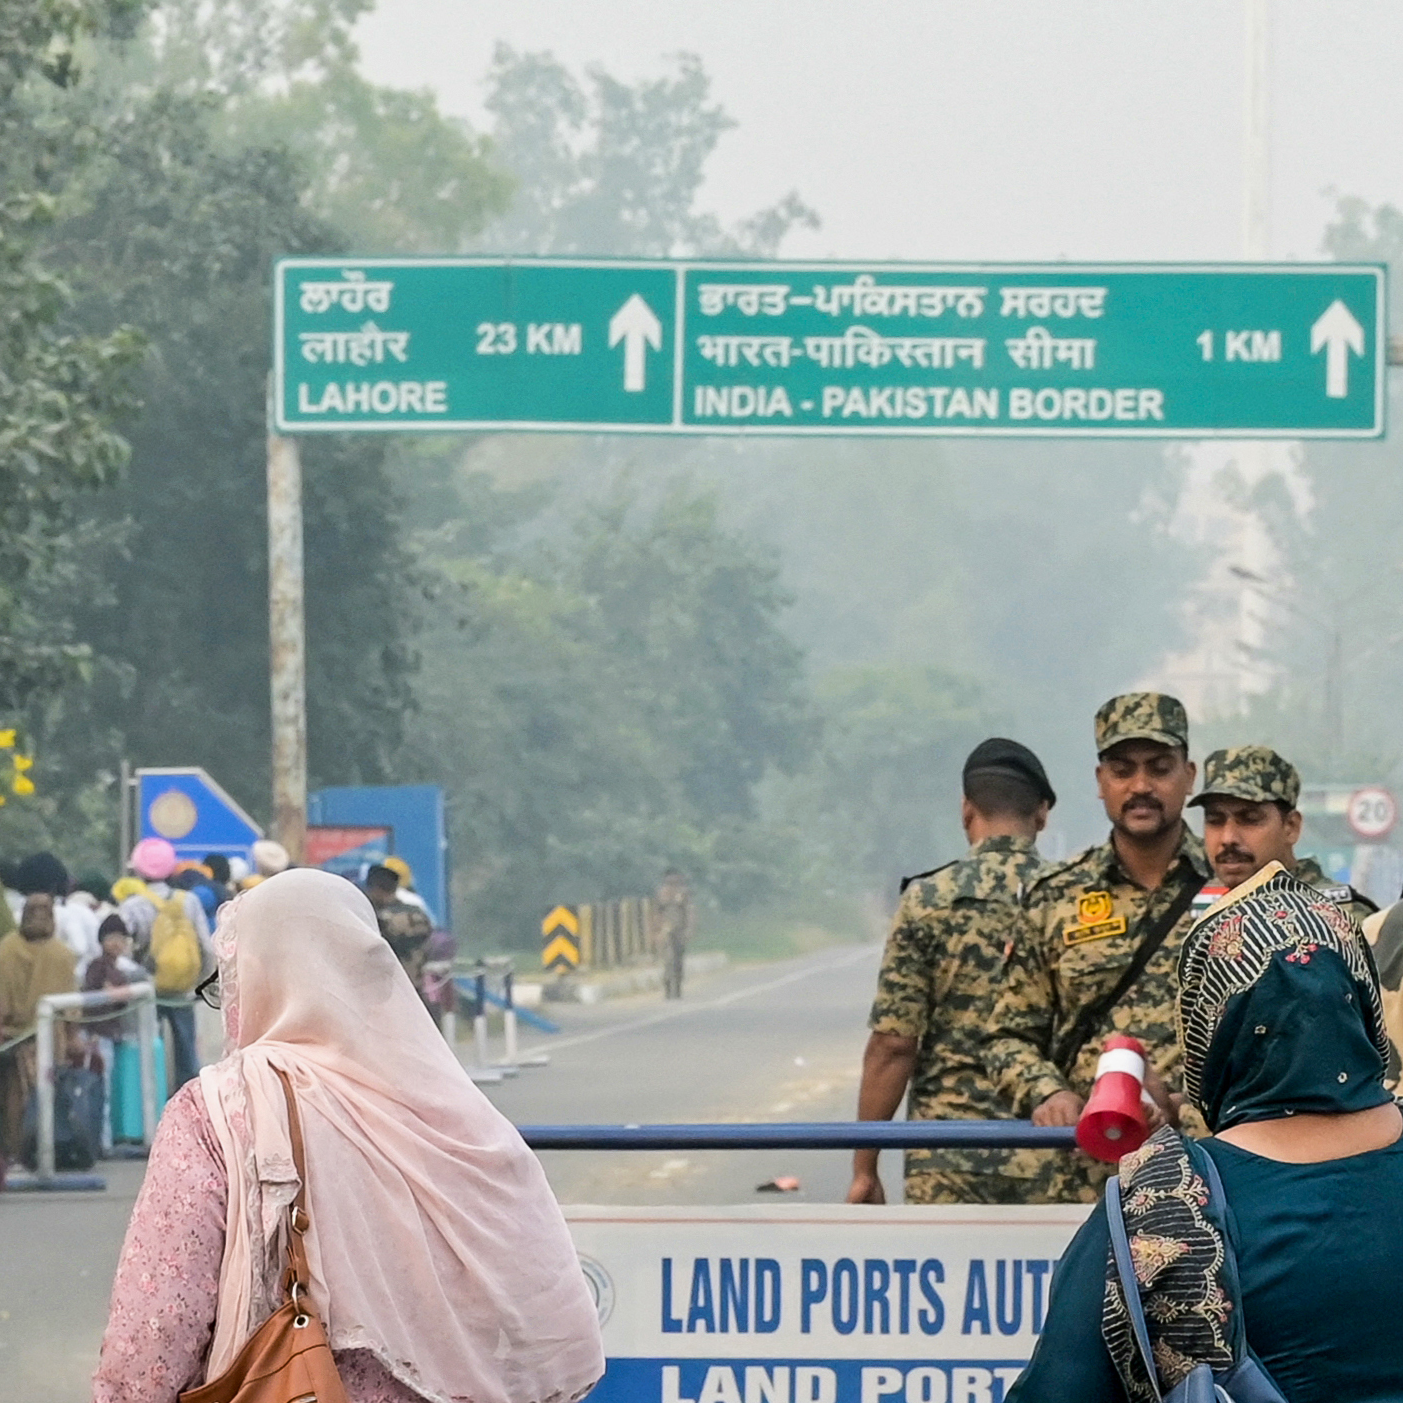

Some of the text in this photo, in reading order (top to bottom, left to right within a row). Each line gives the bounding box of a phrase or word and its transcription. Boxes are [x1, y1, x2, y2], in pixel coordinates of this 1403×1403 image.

[299, 320, 410, 366] लाहौर
[475, 323, 583, 355] 23 KM
[1004, 326, 1097, 369] सीमा
[1196, 330, 1282, 362] 1 KM
[298, 381, 448, 413] LAHORE
[694, 385, 793, 417] INDIA
[822, 386, 999, 419] PAKISTAN
[1009, 388, 1165, 421] BORDER
[1358, 800, 1387, 821] 20
[660, 1258, 782, 1334] LAND
[800, 1258, 945, 1336] PORTS
[960, 1259, 1060, 1336] AUT
